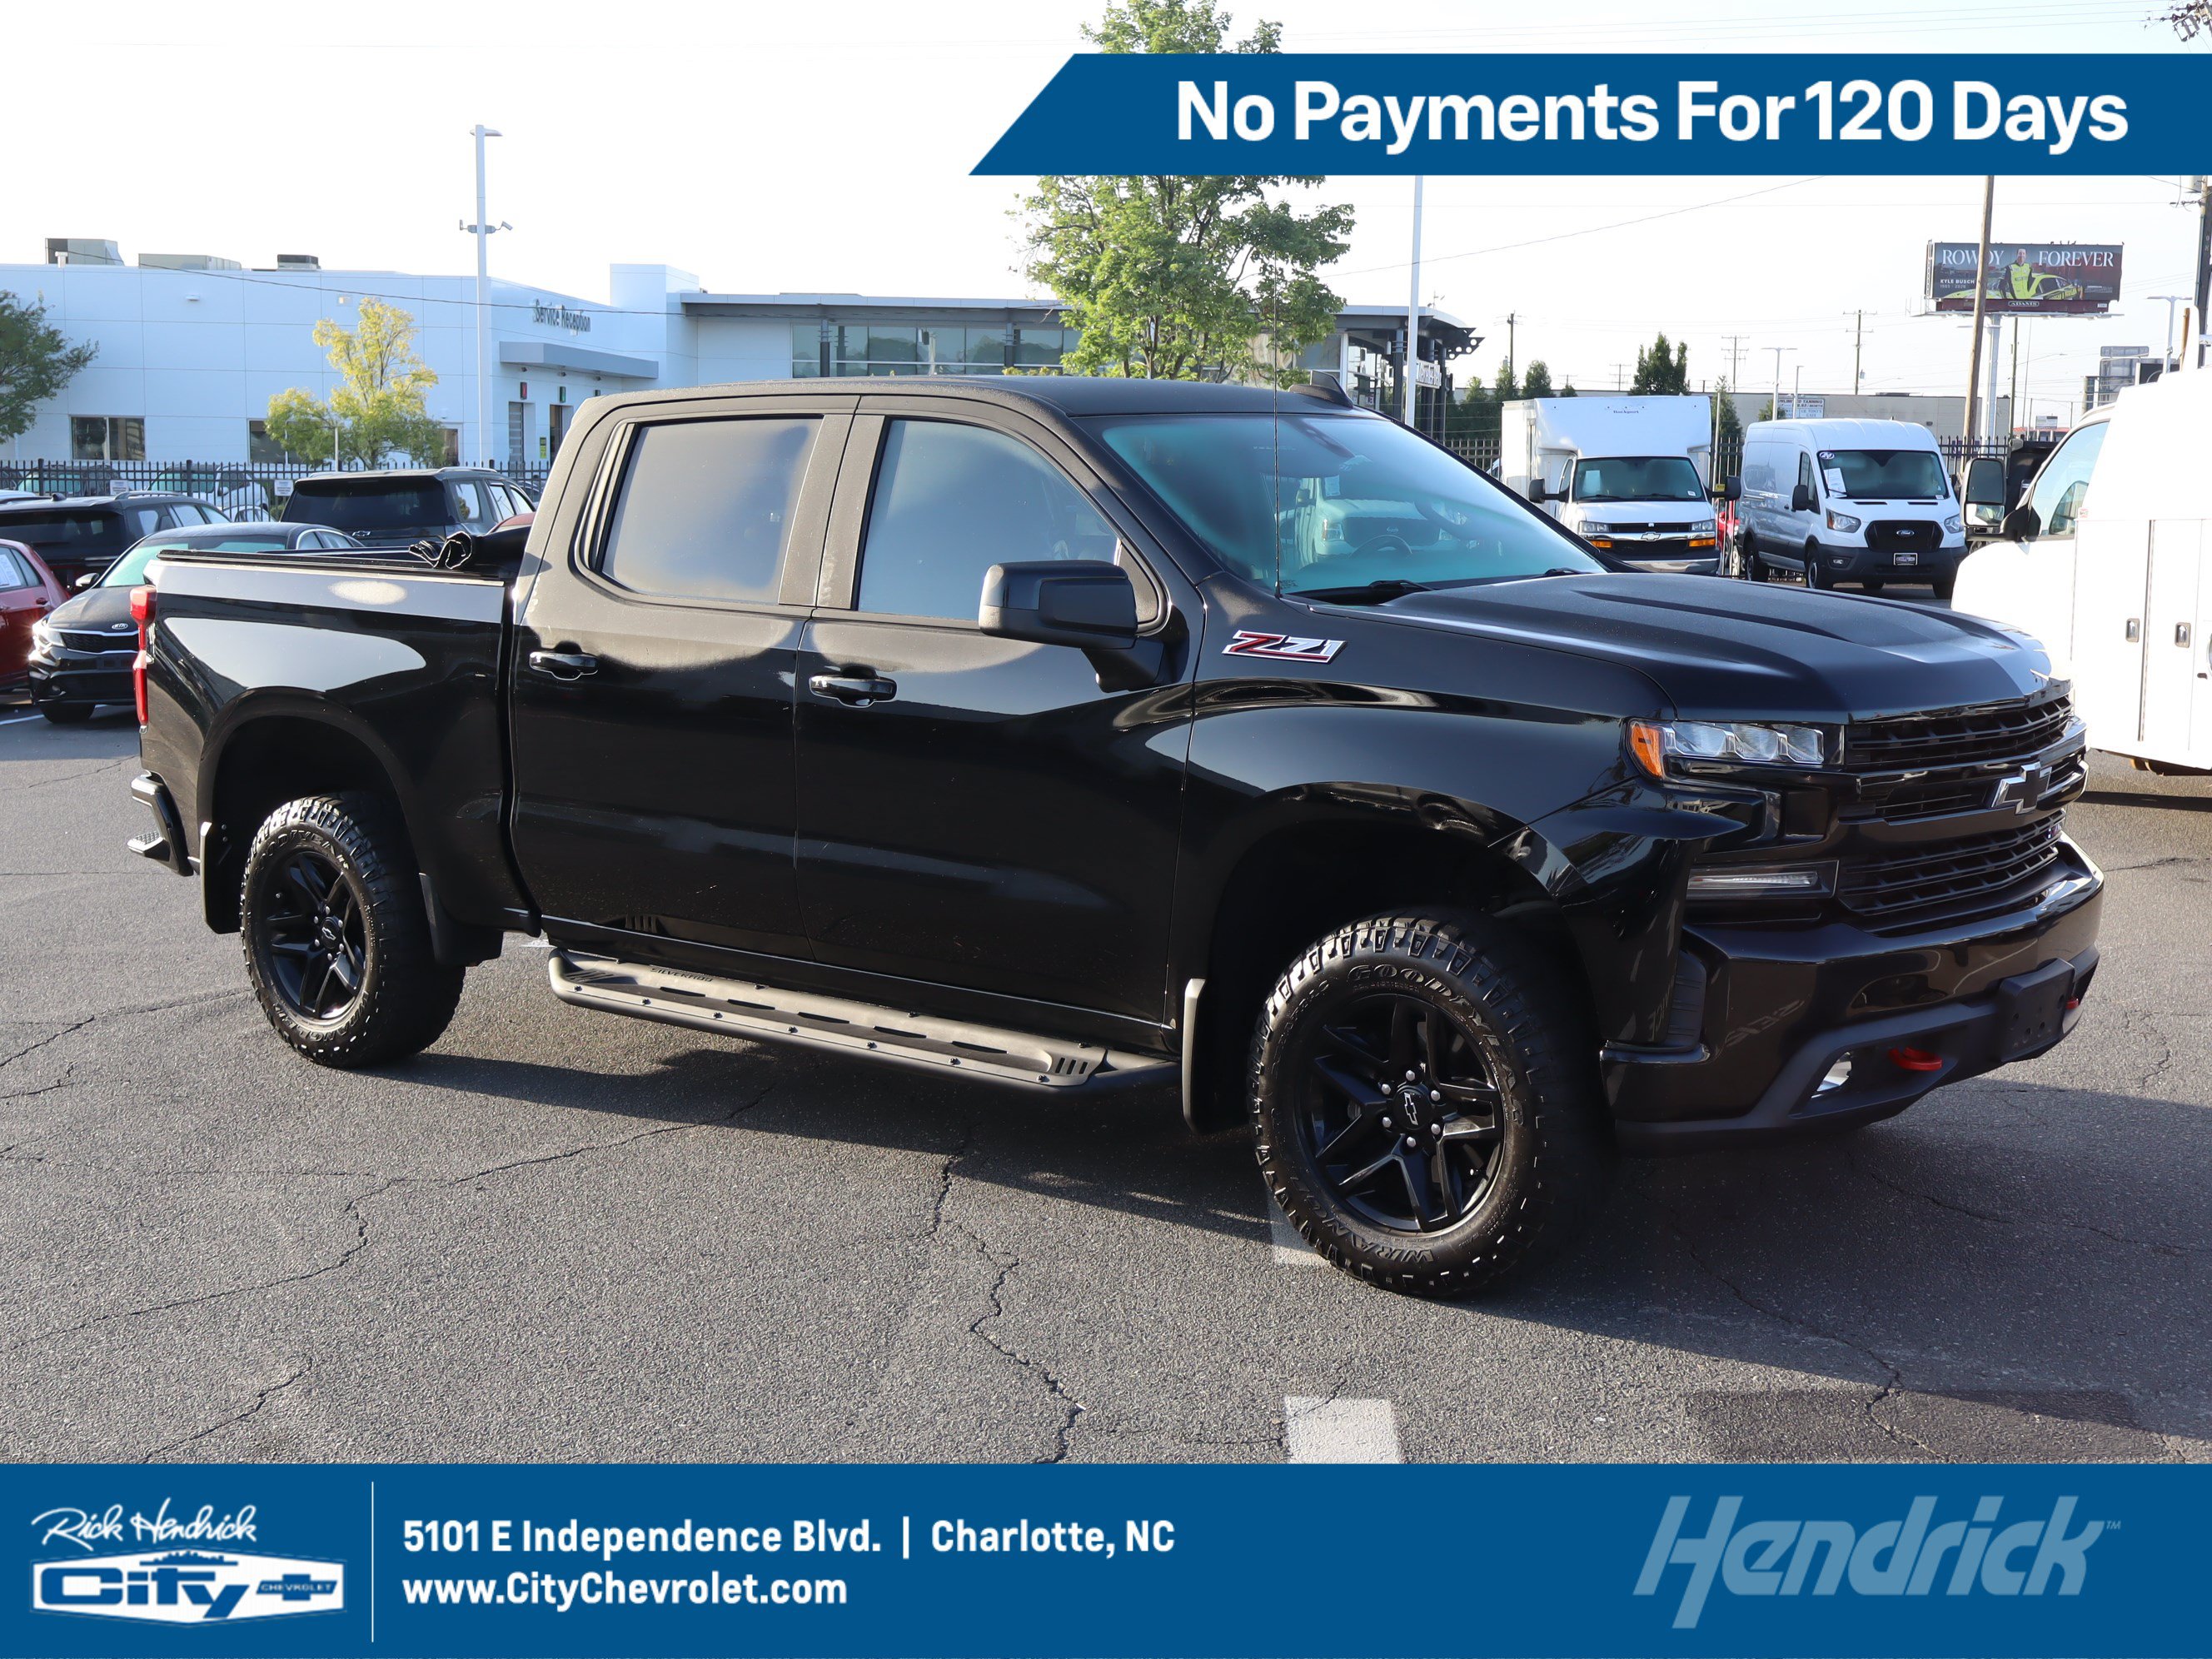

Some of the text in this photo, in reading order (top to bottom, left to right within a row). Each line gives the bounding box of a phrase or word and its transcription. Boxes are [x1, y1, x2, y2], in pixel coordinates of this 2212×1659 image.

[2039, 251, 2114, 267] FOREVER
[534, 299, 590, 335] Service Reception
[1222, 630, 1347, 664] Z71
[650, 968, 715, 982] SILVERADO
